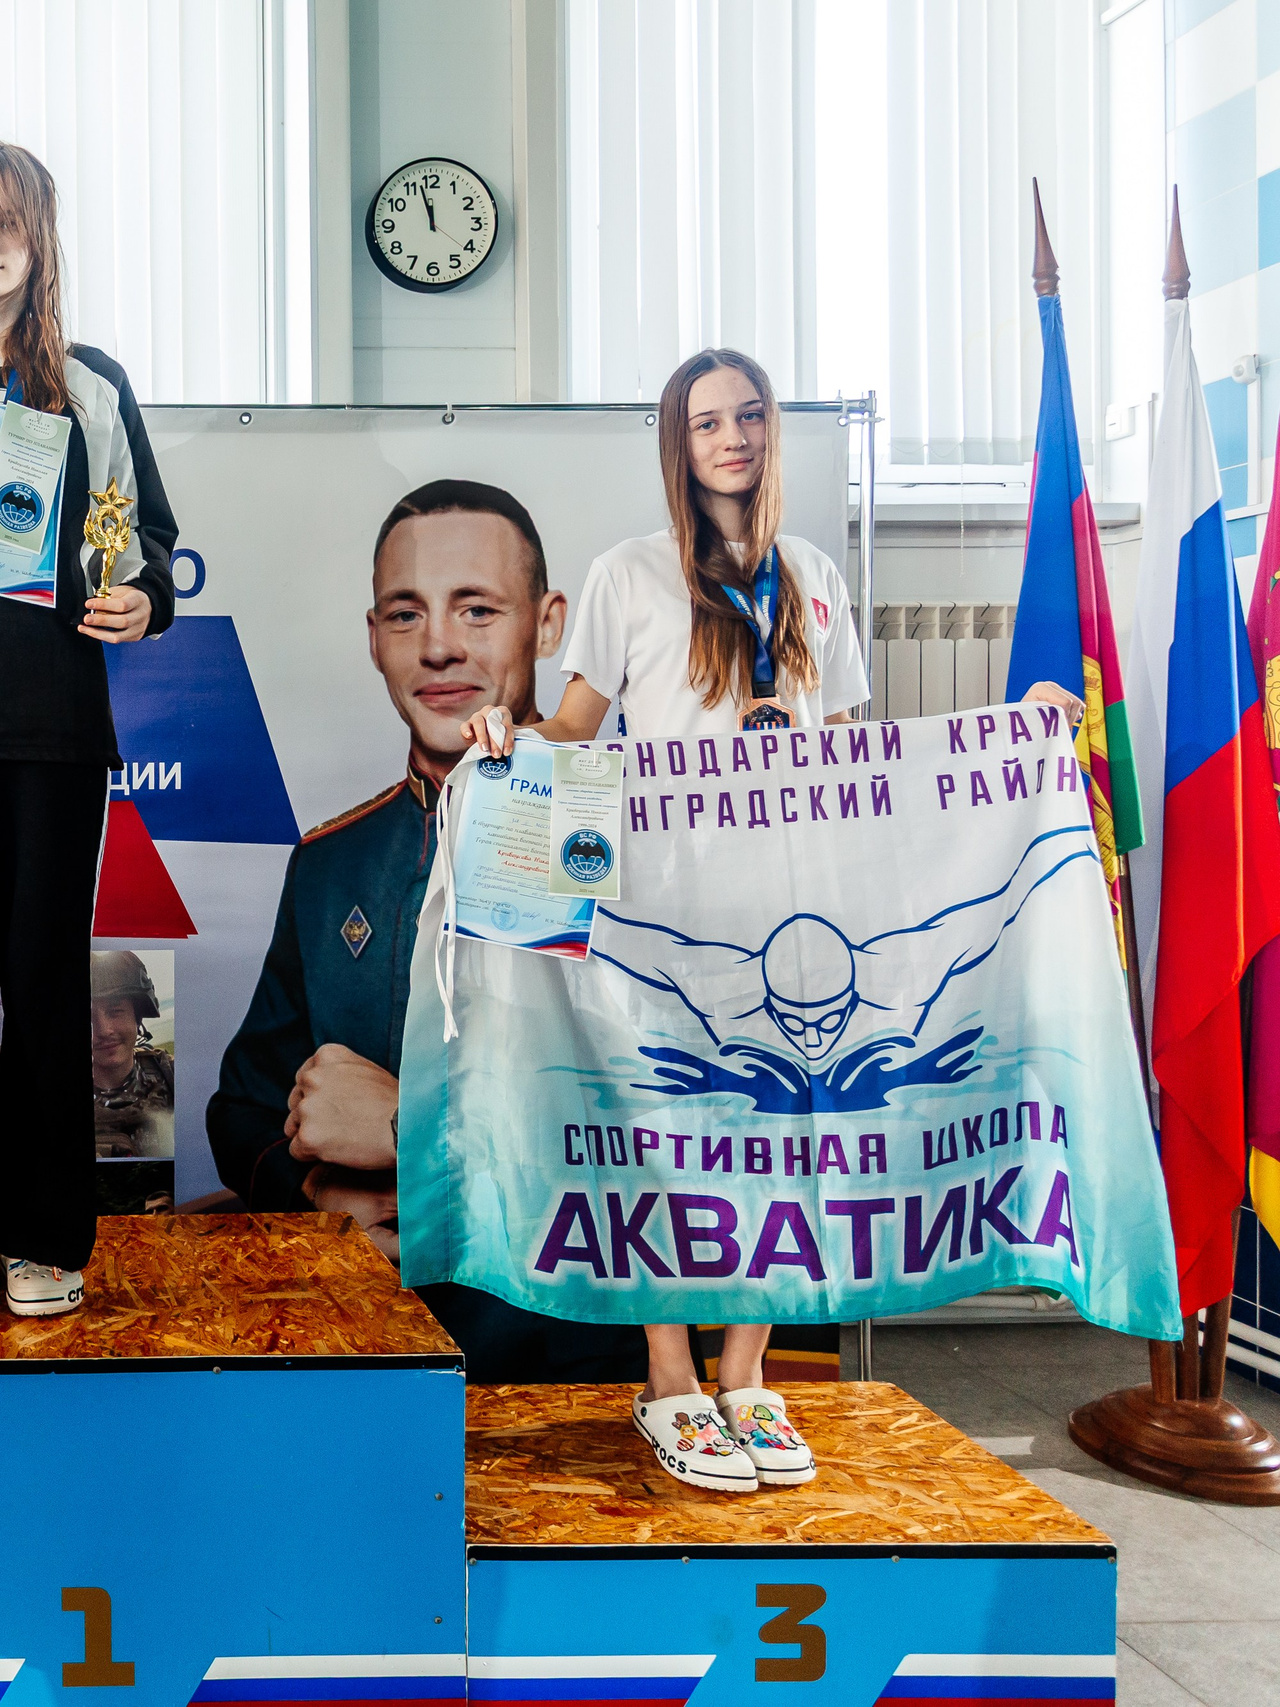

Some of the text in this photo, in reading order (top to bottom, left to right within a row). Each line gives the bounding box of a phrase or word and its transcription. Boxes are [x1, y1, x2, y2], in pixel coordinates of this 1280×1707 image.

[404, 182, 417, 195] 11
[422, 175, 440, 188] 12
[450, 181, 456, 194] 1
[388, 198, 406, 212] 10
[463, 197, 474, 210] 2
[382, 219, 395, 233] 9
[471, 217, 482, 231] 3
[390, 241, 402, 254] 8
[463, 239, 476, 253] 4
[407, 256, 418, 270] 7
[449, 254, 461, 268] 5
[427, 262, 440, 276] 6
[510, 778, 552, 798] ГРАМ
[629, 774, 892, 832] НГРАДСКИЙ
[564, 1101, 1068, 1176] СПОРТИВНАЯ ШКОЛА
[534, 1165, 1080, 1282] АКВАТИКА
[61, 1587, 135, 1688] 1
[754, 1583, 827, 1682] 3
